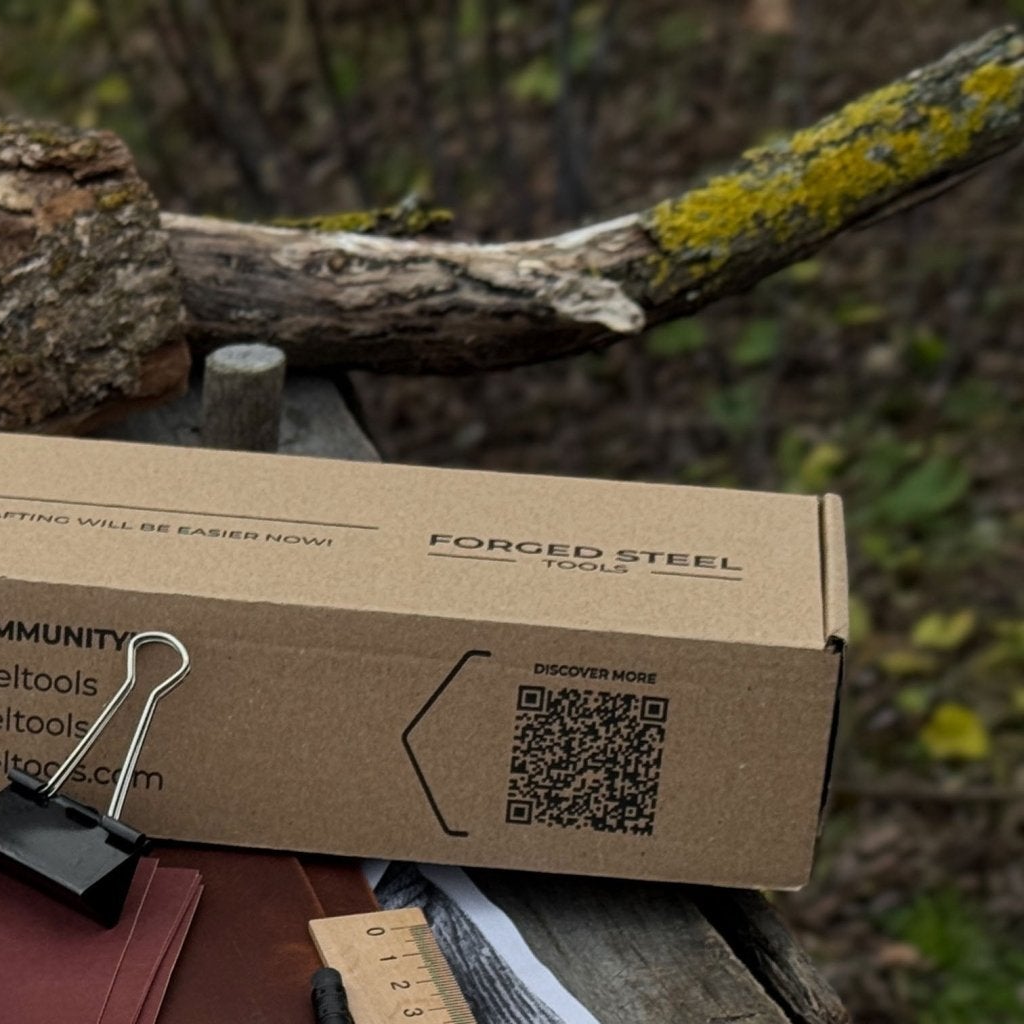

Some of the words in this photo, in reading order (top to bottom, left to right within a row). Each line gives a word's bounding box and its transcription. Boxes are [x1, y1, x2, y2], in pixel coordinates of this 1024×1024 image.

[78, 518, 133, 530] WILL
[140, 523, 170, 534] BE
[178, 526, 259, 540] EASIER
[265, 534, 333, 547] NOW!
[429, 533, 603, 559] FORGED
[616, 549, 743, 572] STEEL
[542, 559, 629, 575] TOOLS
[534, 663, 609, 681] DISCOVER
[612, 669, 657, 685] MORE
[366, 927, 385, 937] 0
[380, 954, 397, 962] 1
[390, 980, 410, 991] 2
[403, 1007, 423, 1018] 3
